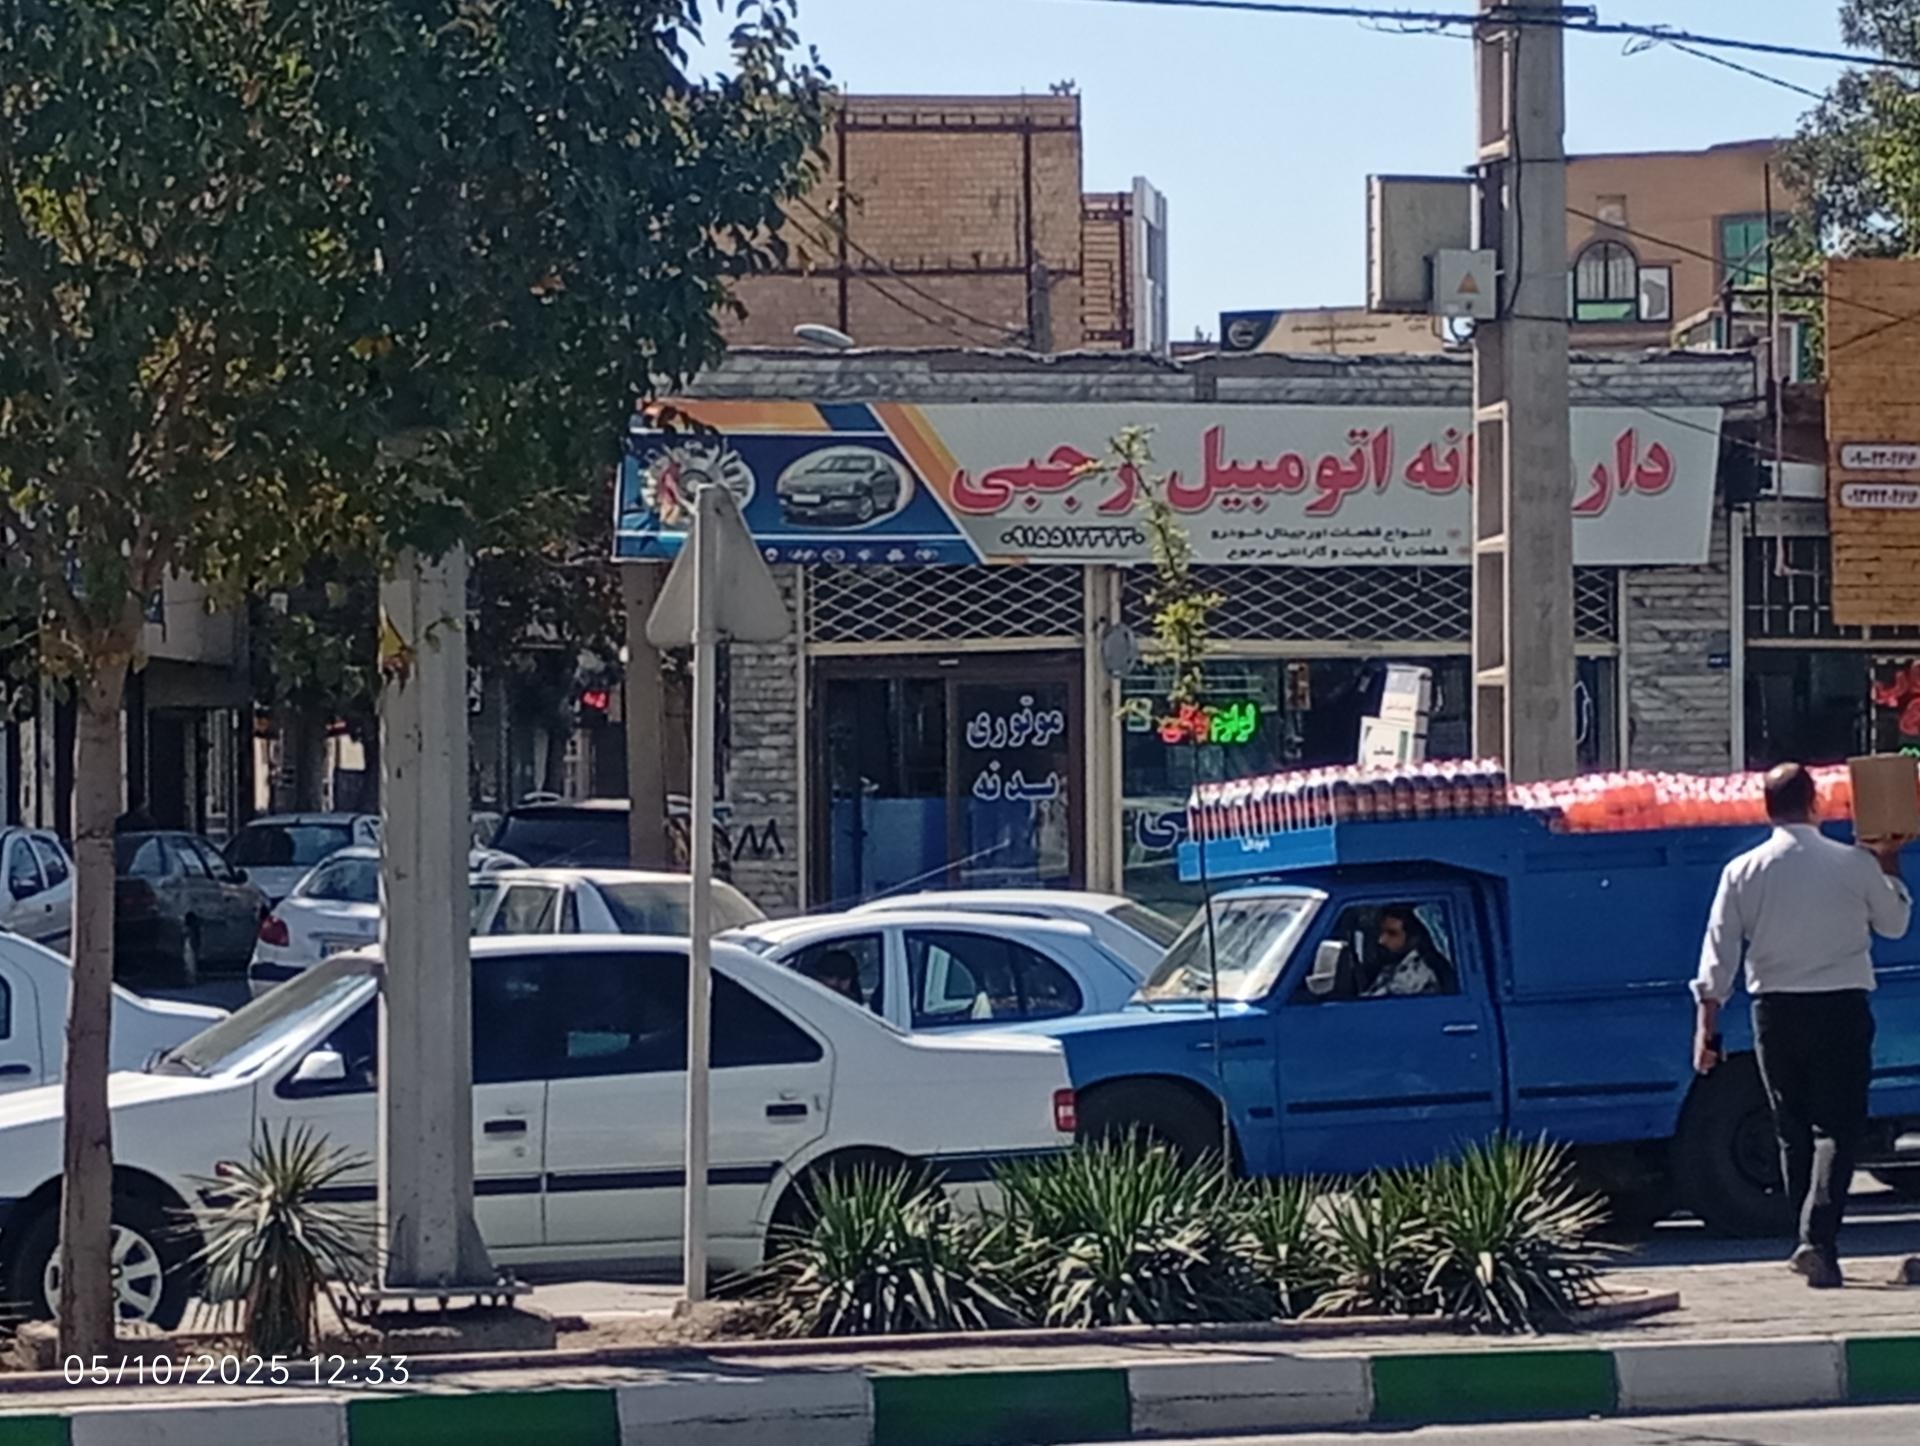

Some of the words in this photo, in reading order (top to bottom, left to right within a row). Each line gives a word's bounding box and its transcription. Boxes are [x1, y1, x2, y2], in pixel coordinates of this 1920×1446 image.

[1166, 423, 1393, 518] اتومبیل
[966, 694, 1065, 749] موتوری
[972, 759, 1060, 812] بدنه
